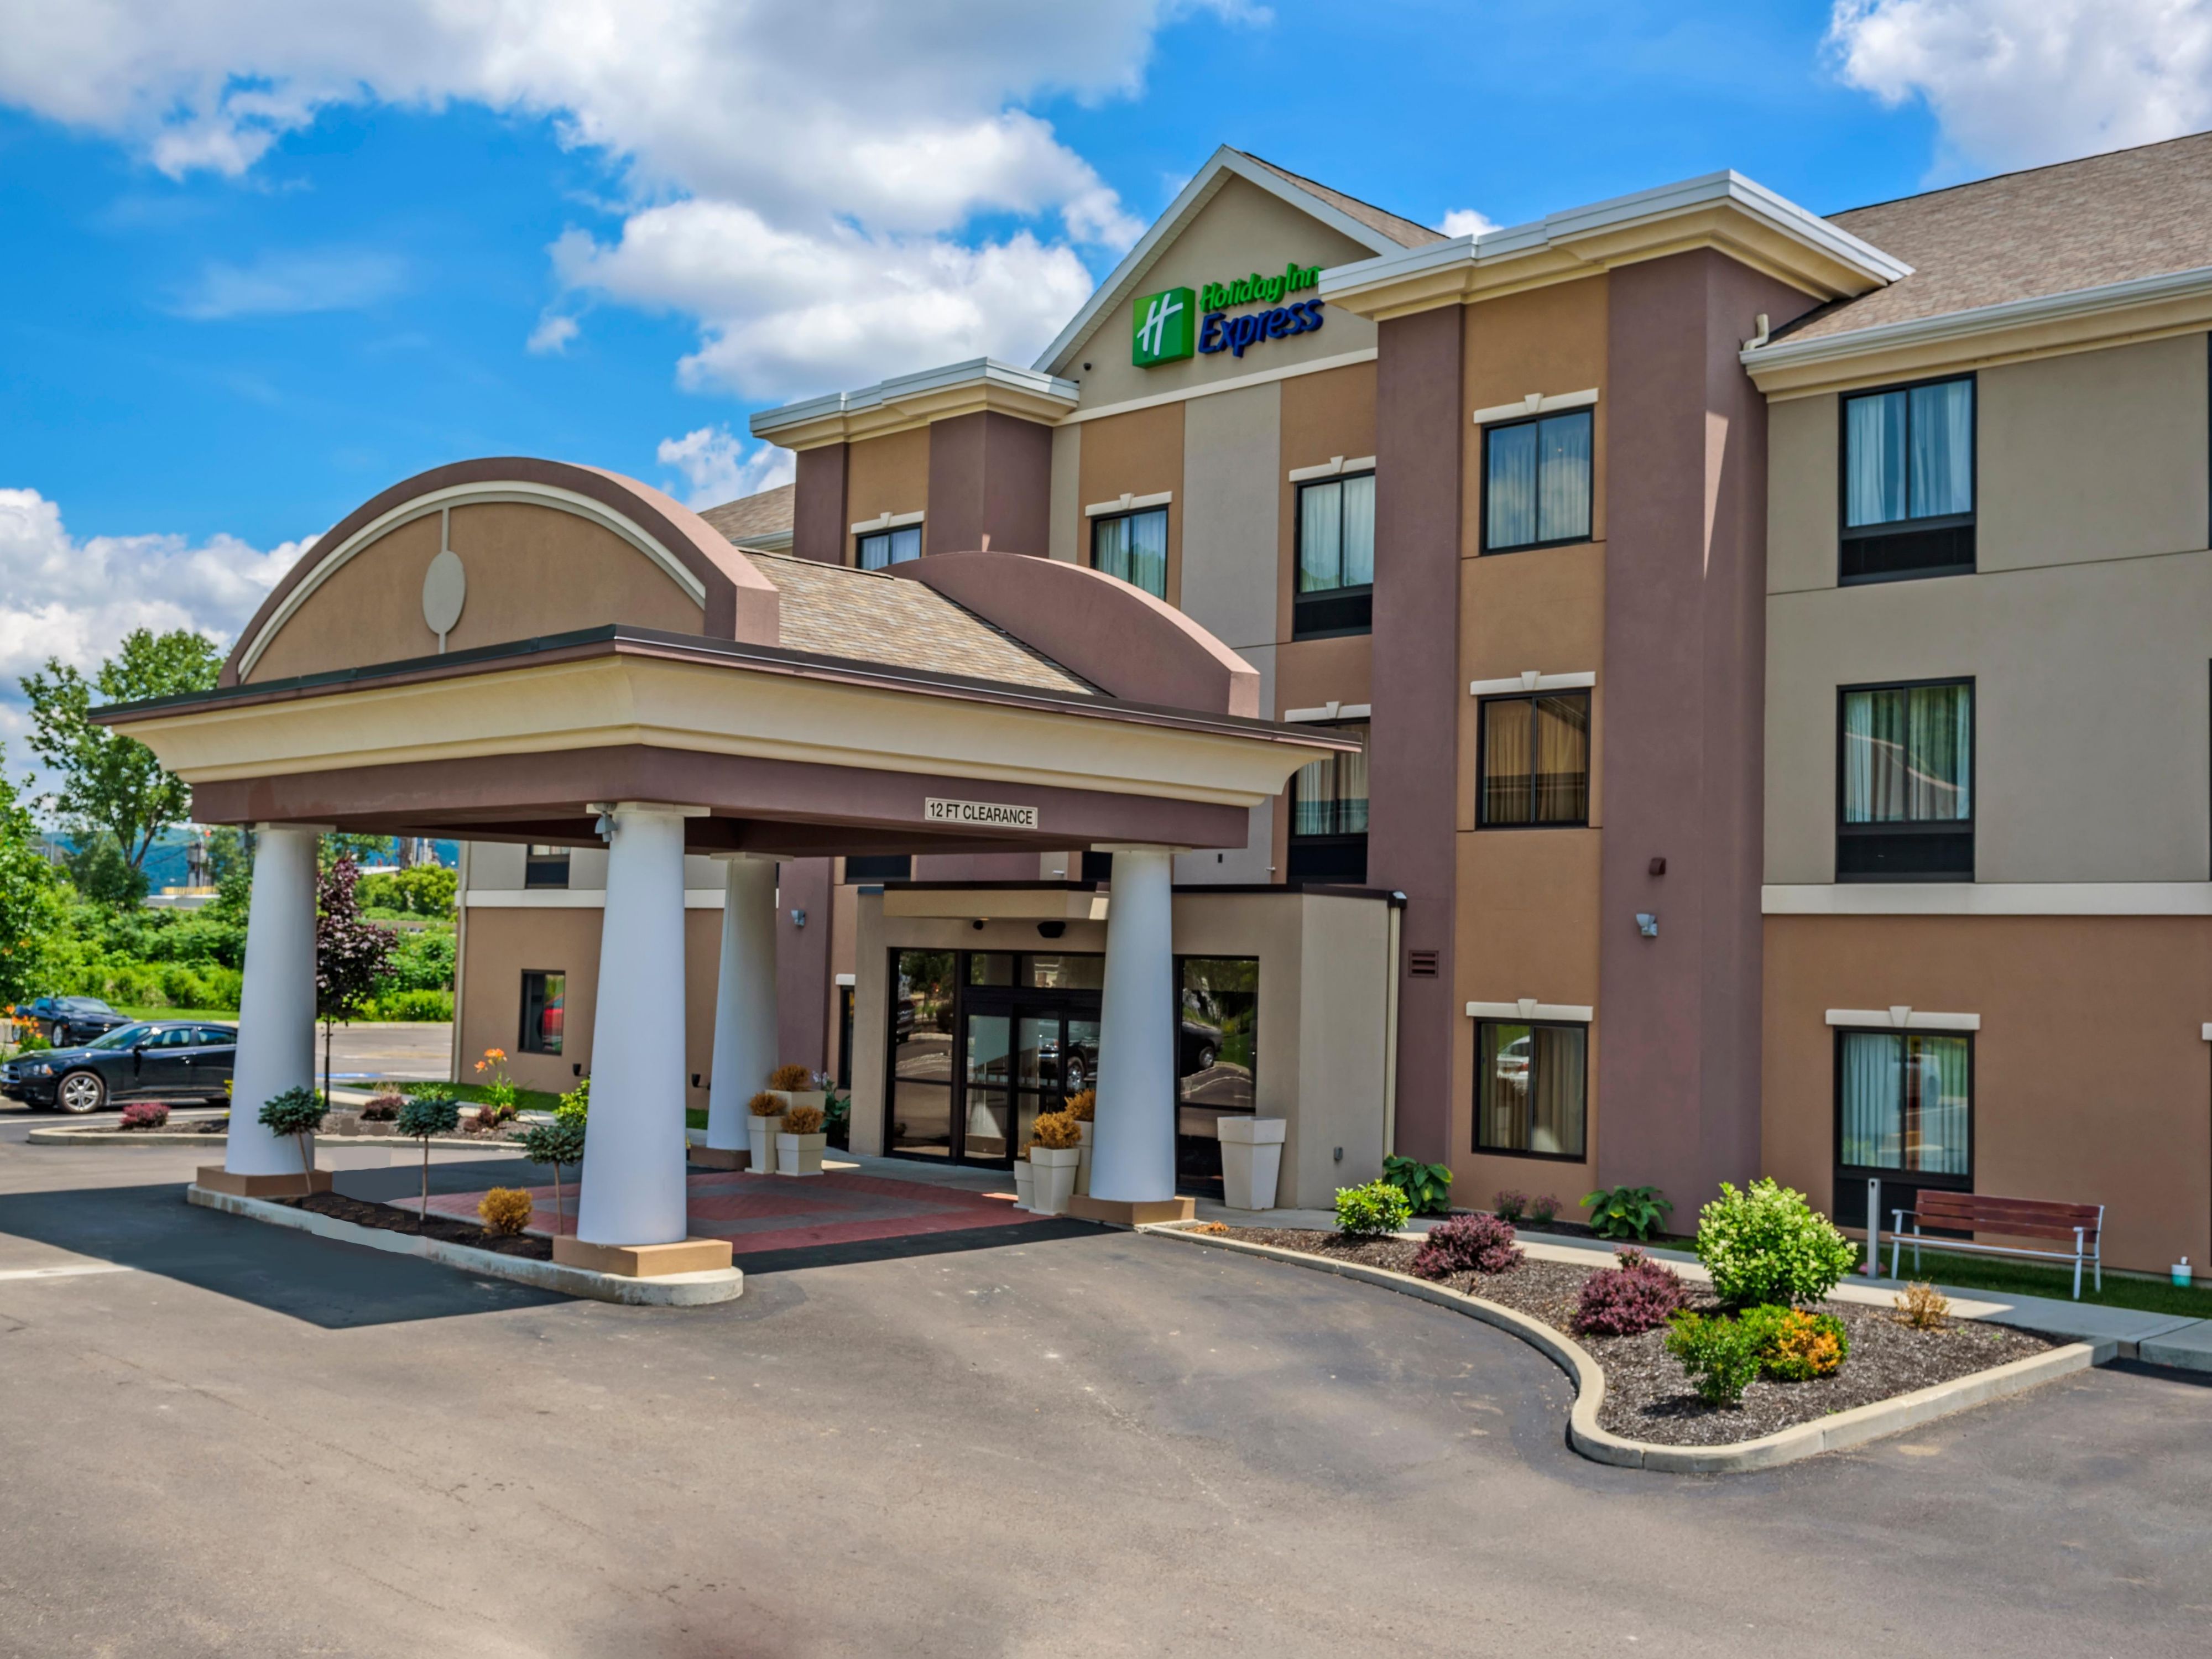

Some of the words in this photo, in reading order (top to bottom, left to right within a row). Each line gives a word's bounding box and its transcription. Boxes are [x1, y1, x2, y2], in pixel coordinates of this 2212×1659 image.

[1199, 273, 1286, 313] Holiday
[1285, 262, 1322, 291] Inn
[1198, 299, 1325, 358] Express
[930, 802, 943, 817] 12
[946, 804, 960, 818] FT
[963, 805, 1032, 825] CLEARANCE
